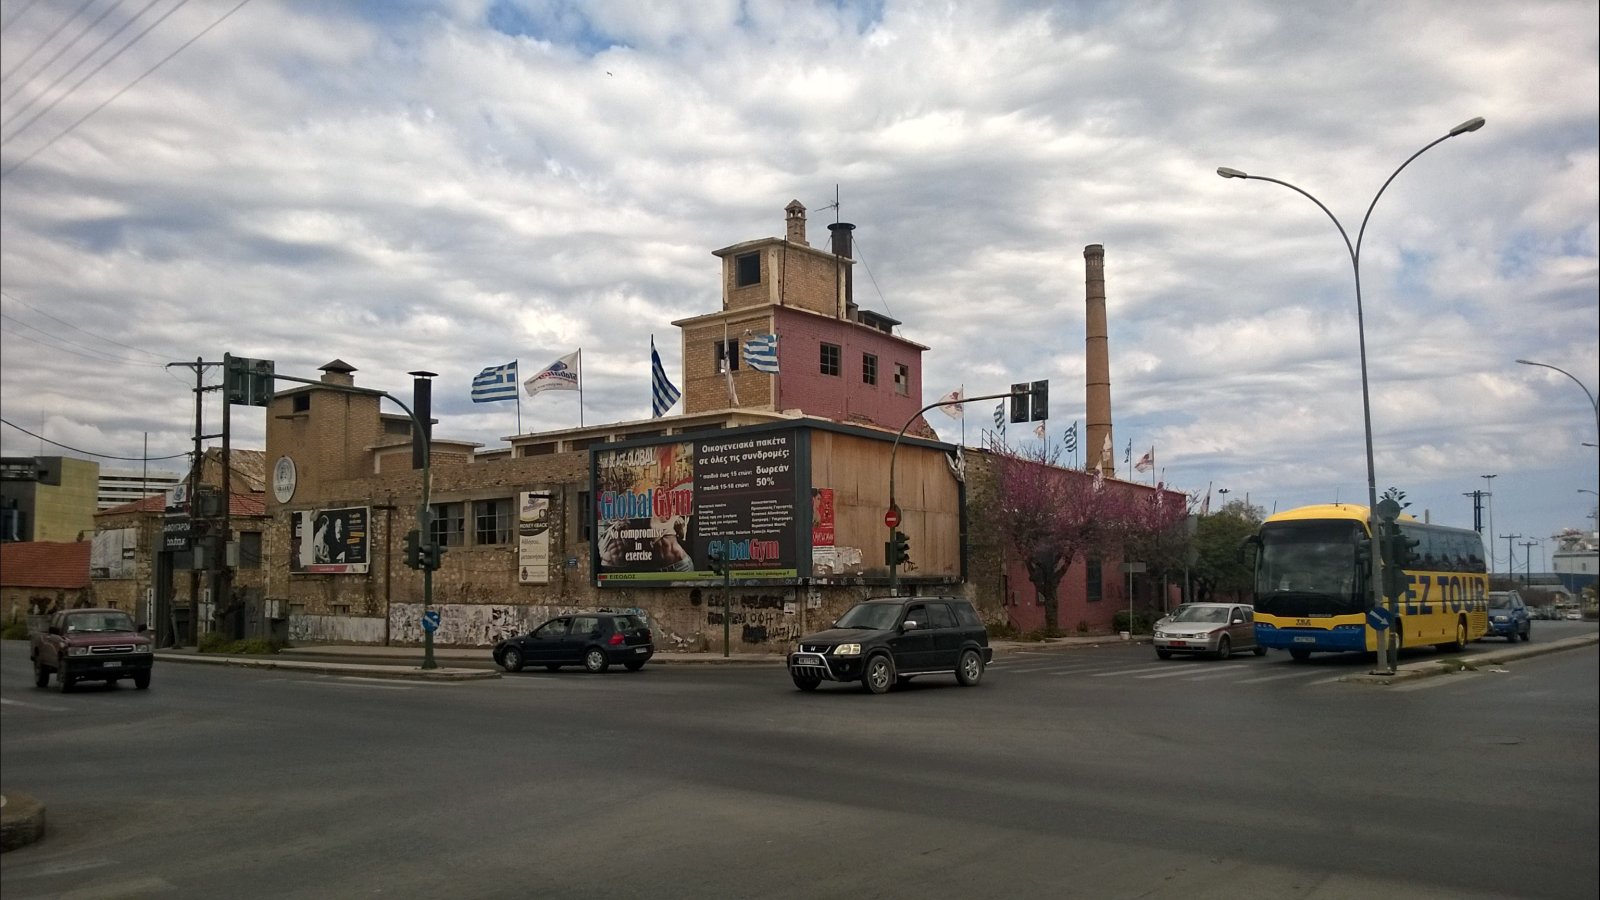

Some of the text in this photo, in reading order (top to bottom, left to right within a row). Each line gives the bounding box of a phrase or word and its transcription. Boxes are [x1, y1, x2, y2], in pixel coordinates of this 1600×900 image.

[702, 437, 786, 453] Οικογενειακά πακέτα
[710, 455, 727, 464] όλες
[730, 454, 740, 463] τις
[742, 448, 790, 460] συνδρομές:
[756, 464, 789, 475] δωρεάν
[756, 477, 775, 487] 50%
[610, 528, 665, 540] No compromise
[635, 541, 642, 550] in
[625, 550, 652, 561] exercise
[1437, 575, 1486, 614] TOUR
